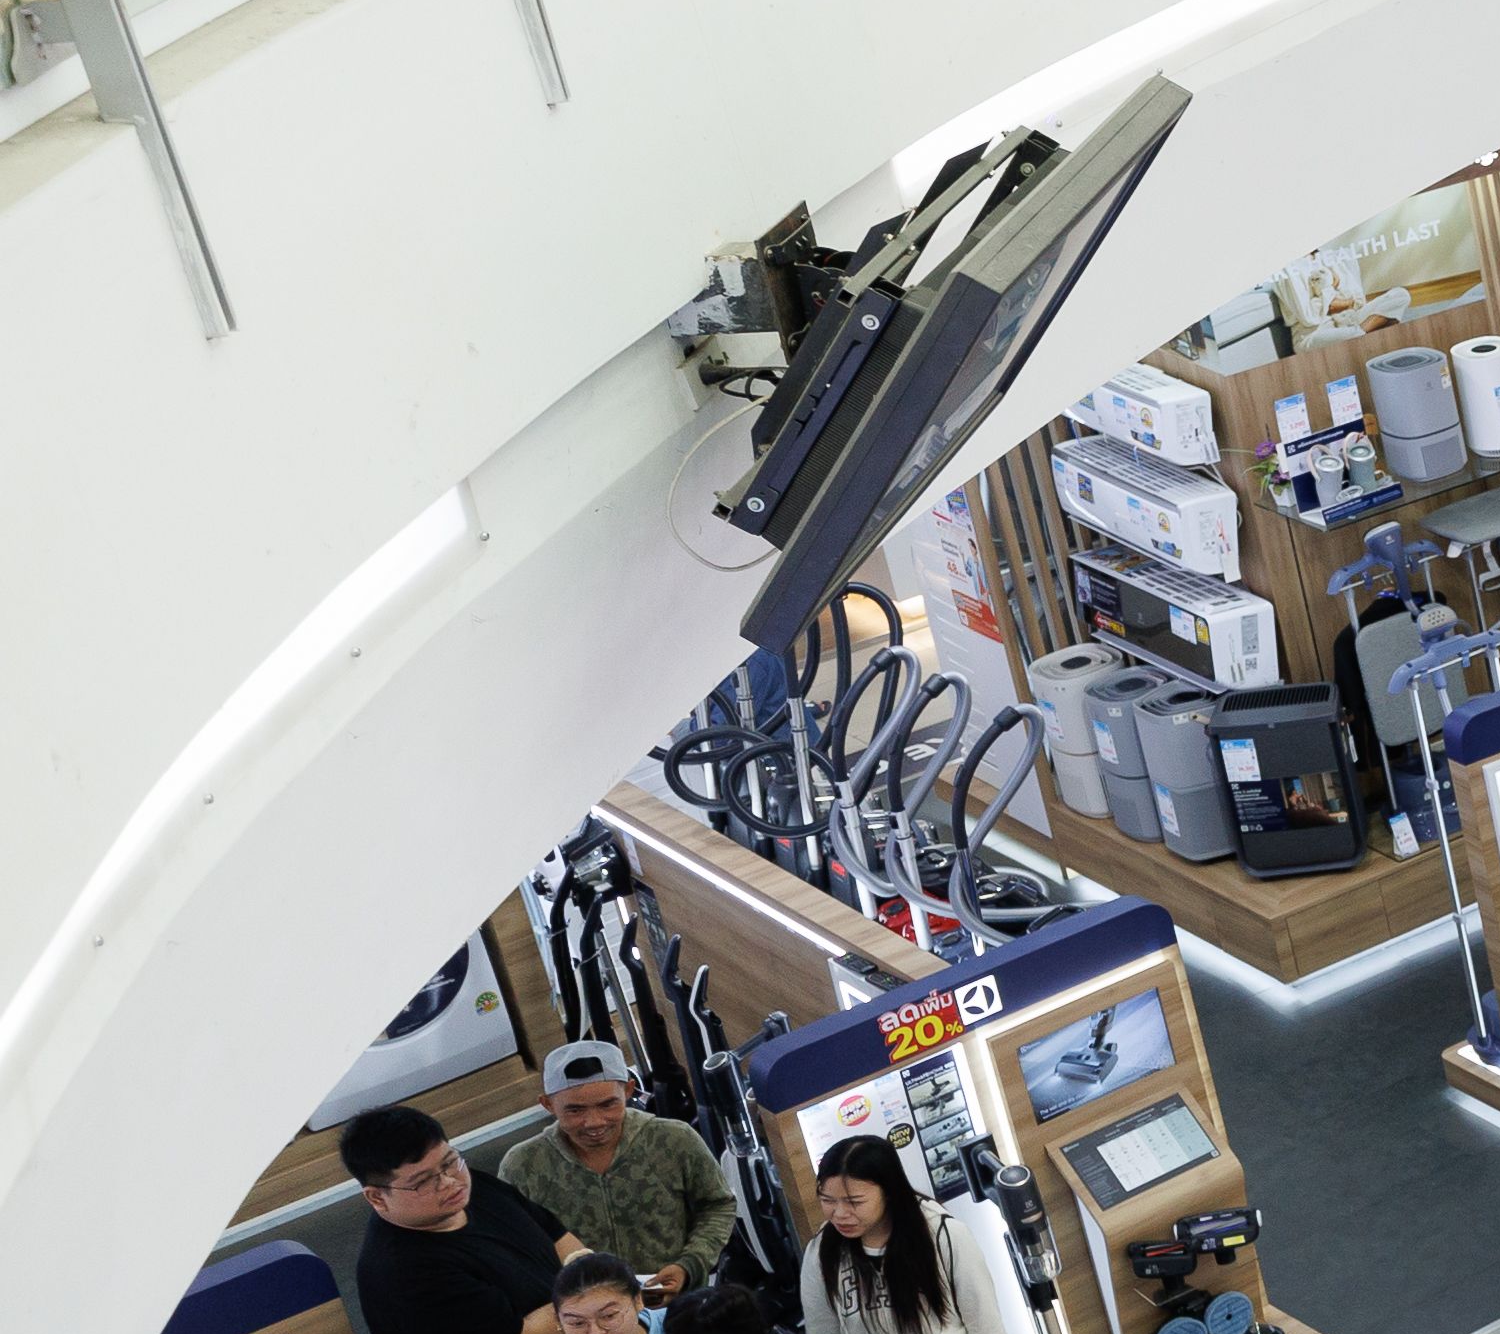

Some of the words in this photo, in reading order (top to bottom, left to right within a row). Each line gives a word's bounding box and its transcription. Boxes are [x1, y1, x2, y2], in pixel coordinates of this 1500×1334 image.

[1394, 220, 1440, 250] LAST
[878, 988, 954, 1033] ลดเพิ่ม
[887, 1014, 964, 1062] 20%
[889, 1128, 911, 1141] NEW
